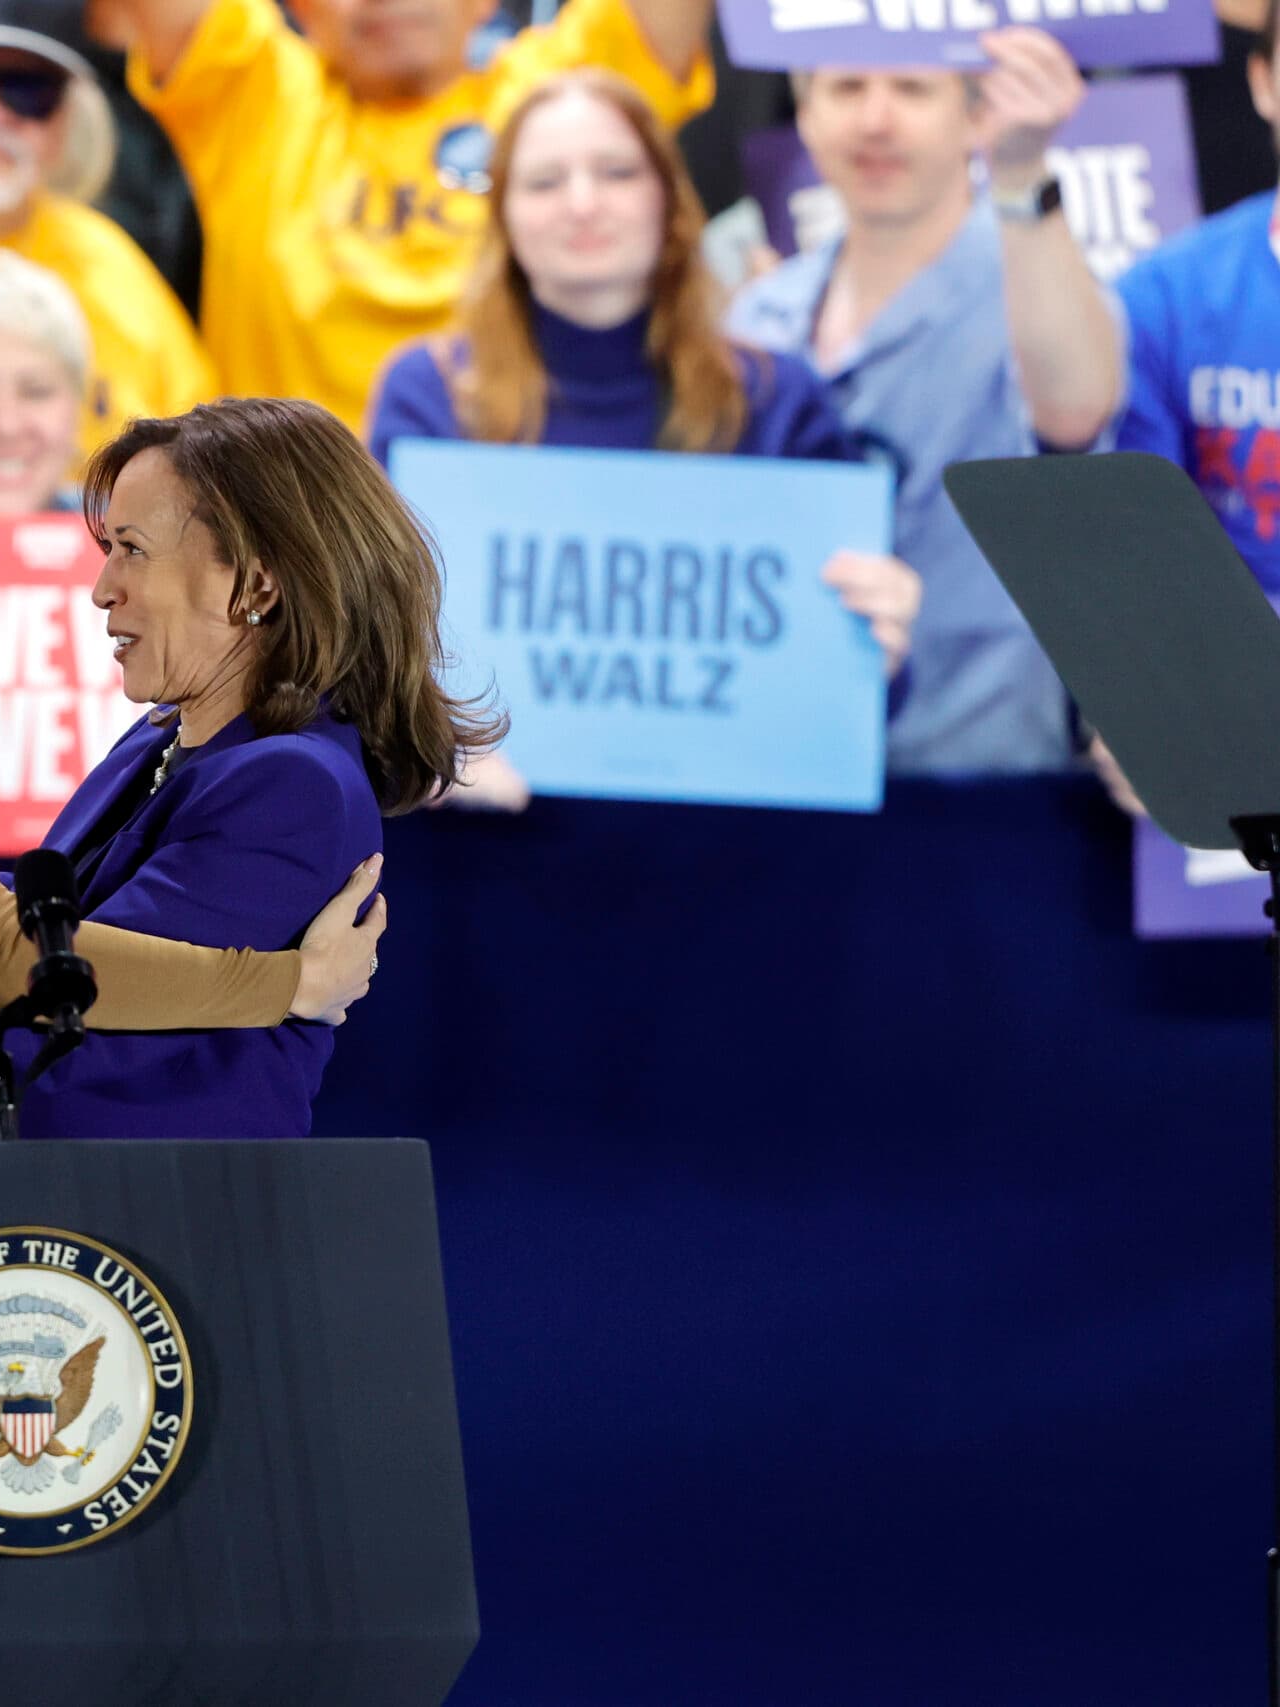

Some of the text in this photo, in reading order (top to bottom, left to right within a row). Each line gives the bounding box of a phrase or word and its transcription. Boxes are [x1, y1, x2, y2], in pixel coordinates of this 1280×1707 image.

[1044, 144, 1161, 250] OTE
[483, 530, 787, 648] HARRIS
[529, 645, 740, 716] WALZ
[22, 1238, 81, 1271] THE
[92, 1254, 184, 1390] UNITED
[81, 1409, 182, 1533] STATES
